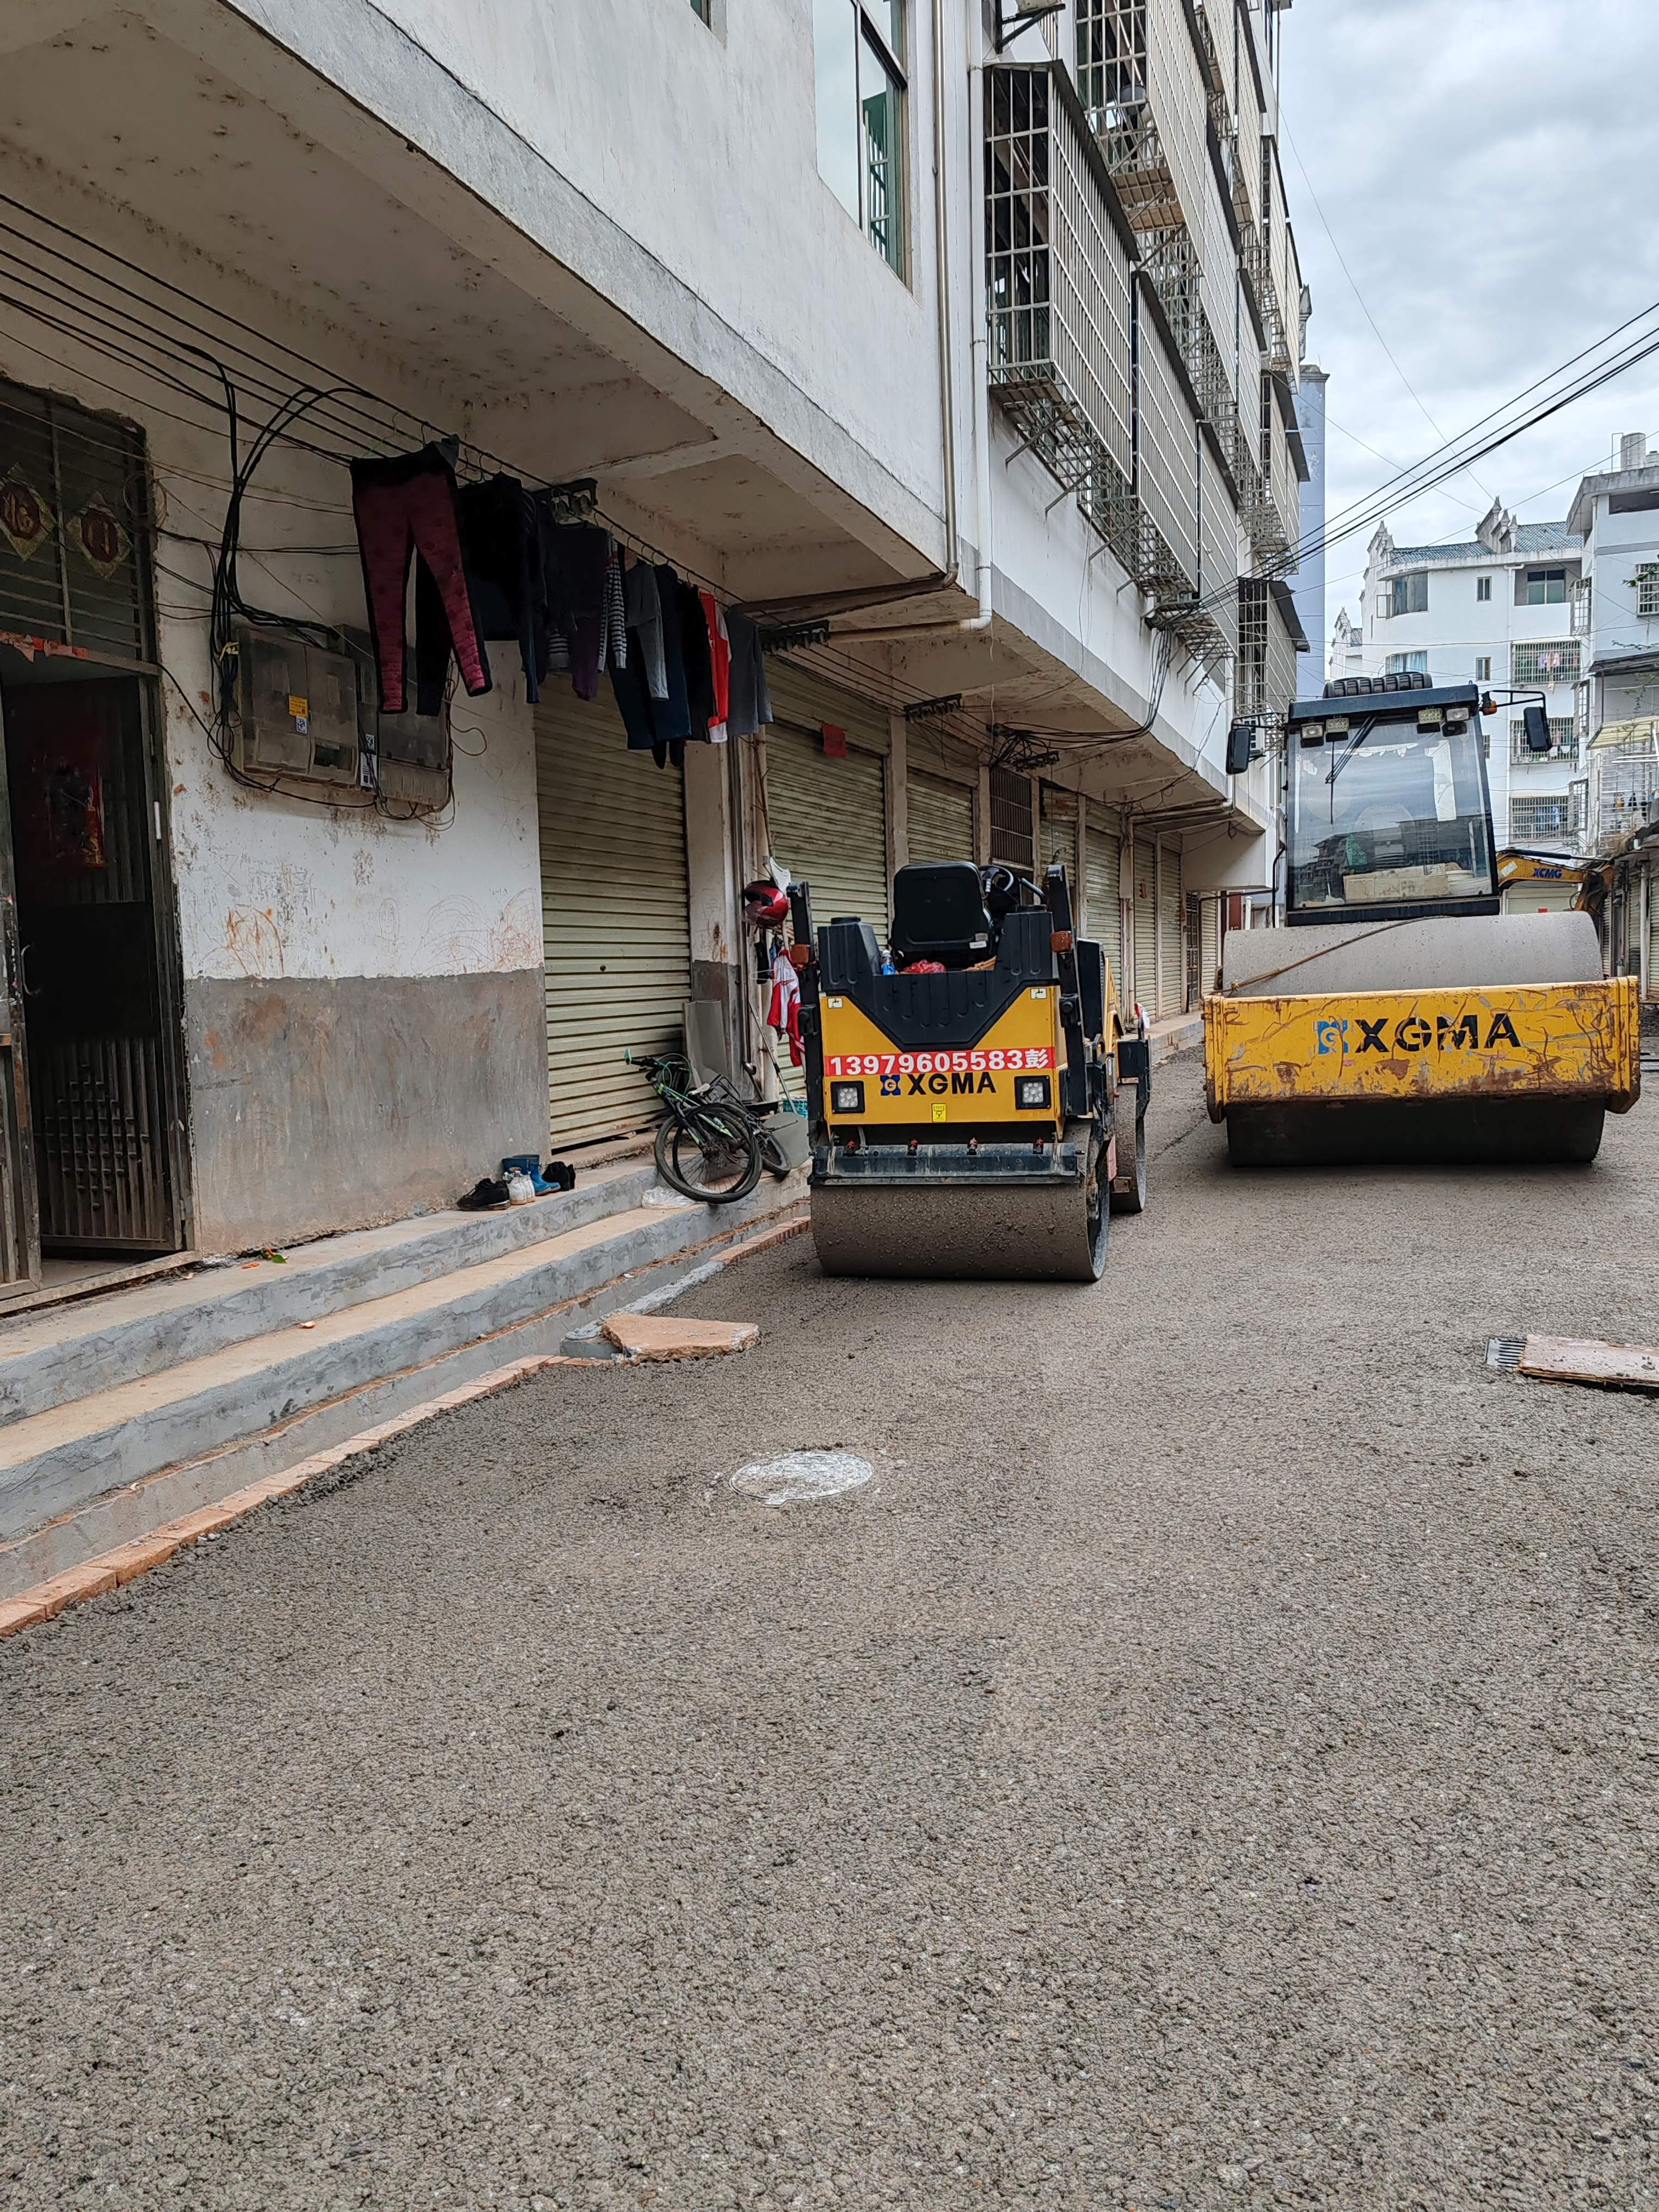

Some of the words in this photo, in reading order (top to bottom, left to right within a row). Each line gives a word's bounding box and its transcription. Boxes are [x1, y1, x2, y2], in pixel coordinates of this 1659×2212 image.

[1533, 868, 1563, 878] XCMG
[1354, 1013, 1521, 1053] XGMA
[831, 1048, 1049, 1076] 13979605583彭
[908, 1072, 997, 1095] XGMA
